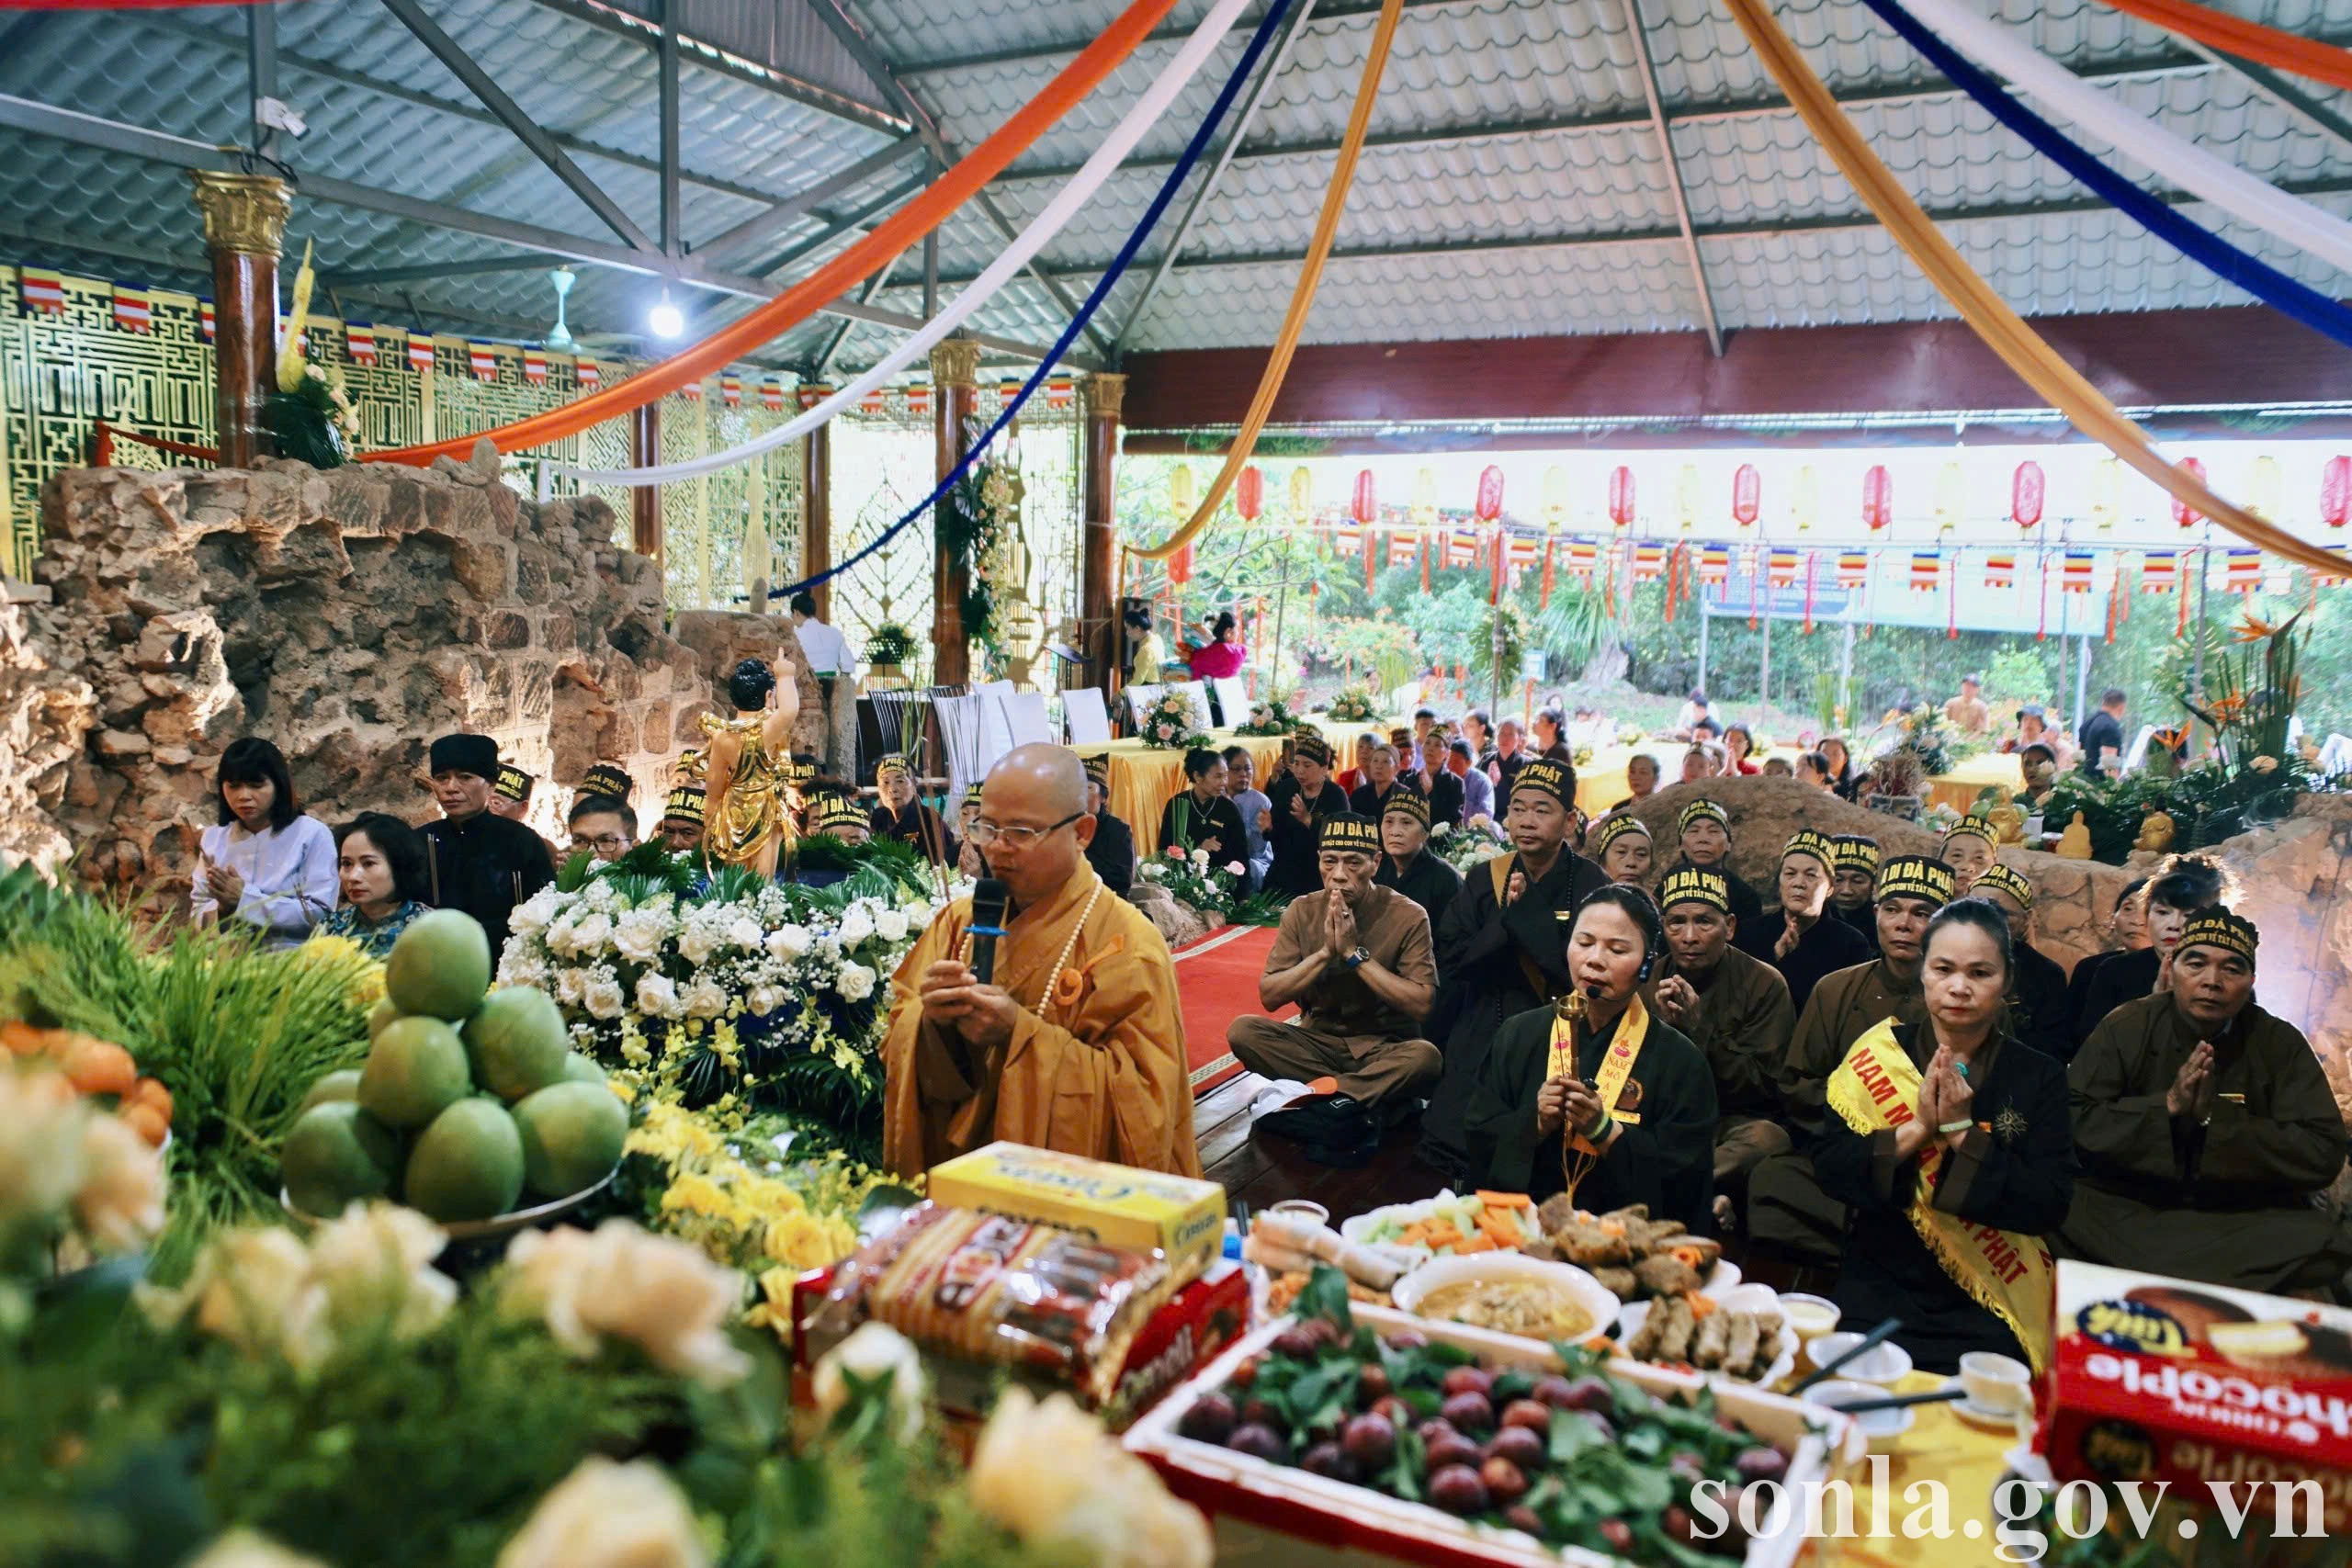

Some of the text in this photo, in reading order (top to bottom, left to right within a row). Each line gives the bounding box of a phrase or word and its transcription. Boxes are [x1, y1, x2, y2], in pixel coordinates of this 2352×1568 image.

[497, 770, 525, 789] PHẬT
[1529, 764, 1563, 784] PHẬT
[685, 793, 707, 815] PHẬ
[830, 795, 844, 813] ĐÀ
[1325, 823, 1332, 836] A
[1332, 822, 1345, 836] DI
[1347, 820, 1363, 837] ĐÀ
[1802, 831, 1818, 845] ĐÀ
[1841, 840, 1857, 855] ĐÀ
[1888, 863, 1903, 882] DI
[1902, 859, 1924, 880] ĐÀ
[1927, 866, 1955, 897] PHẬT
[1988, 864, 2009, 880] ĐÀ
[1668, 874, 1679, 893] DI
[1680, 867, 1700, 887] ĐÀ
[1702, 873, 1728, 898] PHẬT
[2204, 917, 2227, 931] ĐÀ
[1604, 1069, 1621, 1081] MÔ
[1849, 1046, 1916, 1127] NAM M
[1973, 1225, 2029, 1286] PHẬT
[2085, 1352, 2352, 1438] hocoPie
